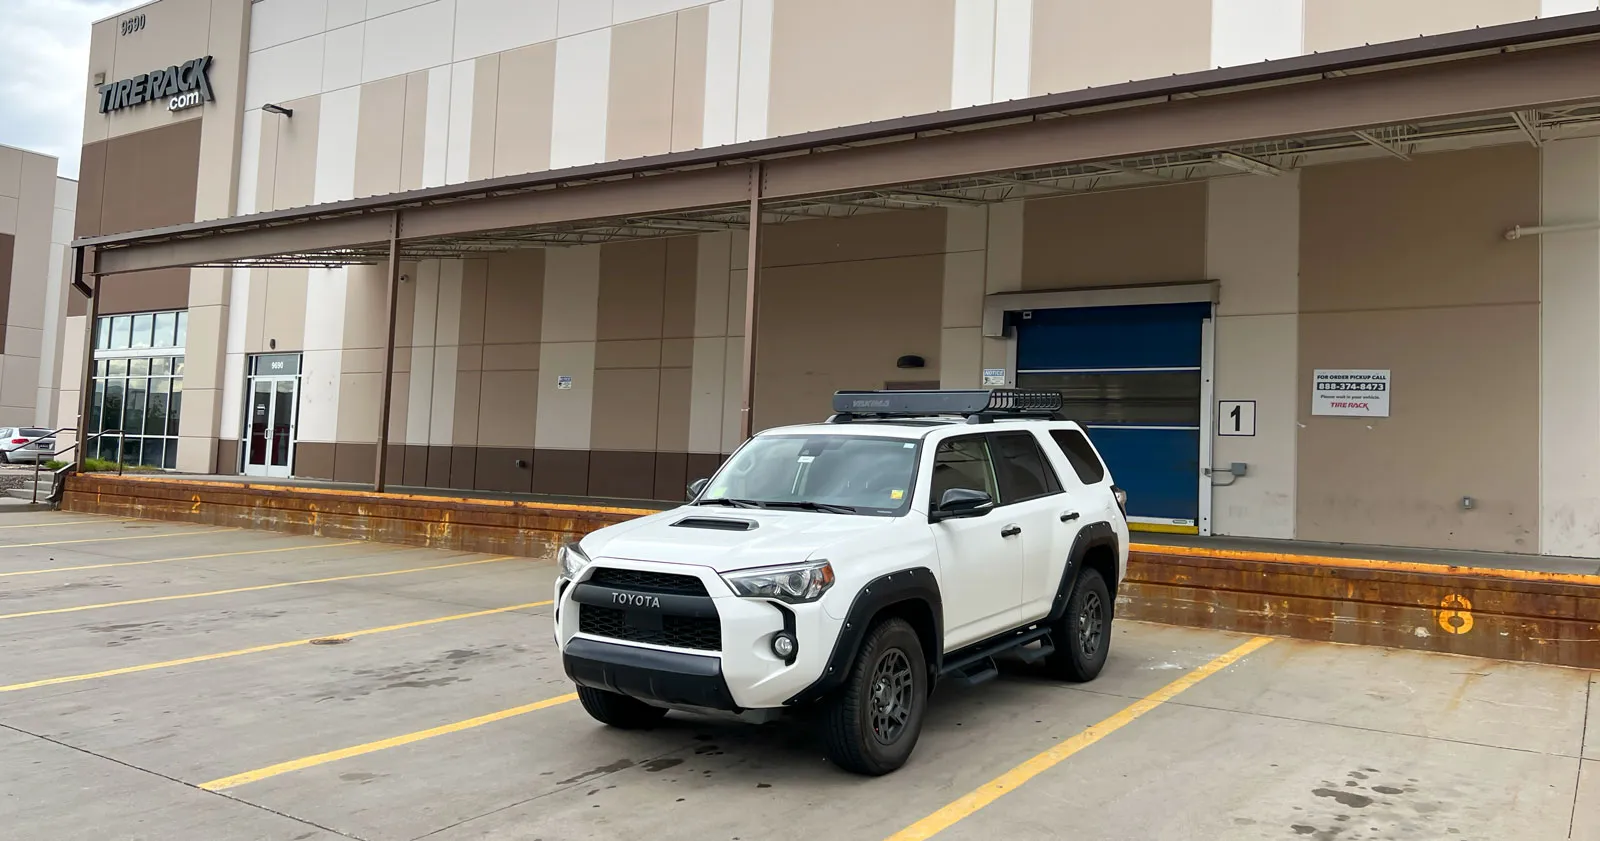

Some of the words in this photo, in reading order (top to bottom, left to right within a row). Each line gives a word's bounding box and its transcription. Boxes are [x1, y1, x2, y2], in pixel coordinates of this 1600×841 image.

[121, 14, 146, 36] 9690
[166, 91, 199, 111] .com
[1348, 402, 1369, 411] RACK
[1230, 405, 1241, 432] 1
[191, 493, 201, 514] 2
[612, 592, 660, 608] TOYOTA
[1438, 593, 1474, 635] 8
